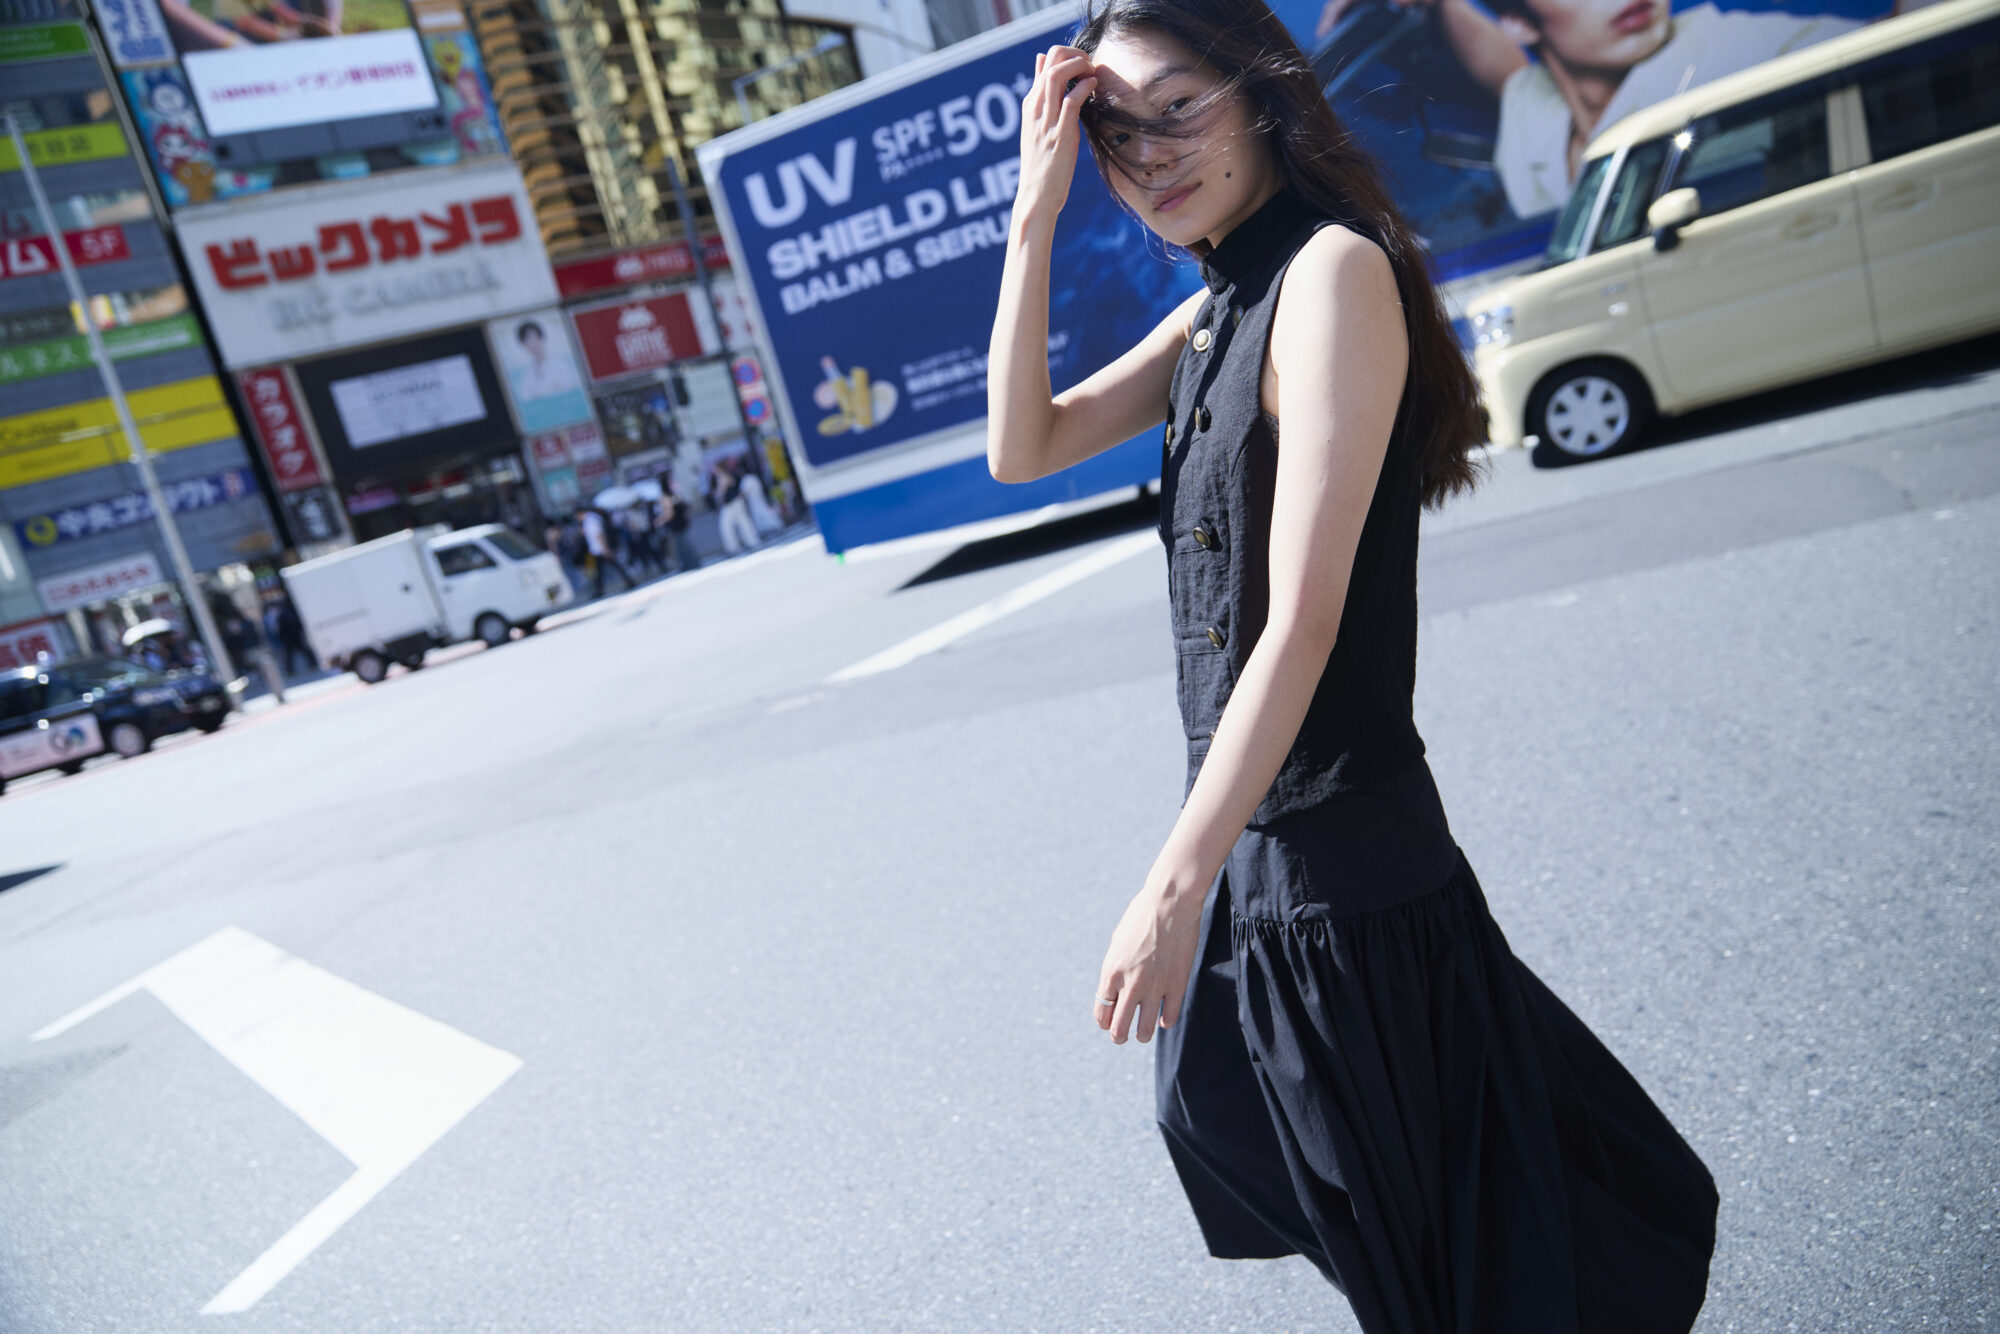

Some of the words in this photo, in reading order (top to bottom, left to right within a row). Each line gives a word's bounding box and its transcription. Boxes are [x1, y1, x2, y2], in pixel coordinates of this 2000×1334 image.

[872, 109, 936, 162] SPF
[743, 137, 857, 230] UV
[204, 195, 522, 291] ビックカメラ
[768, 187, 949, 280] SHIELD
[780, 256, 883, 316] BALM
[883, 248, 915, 280] &
[914, 209, 1013, 269] SERU
